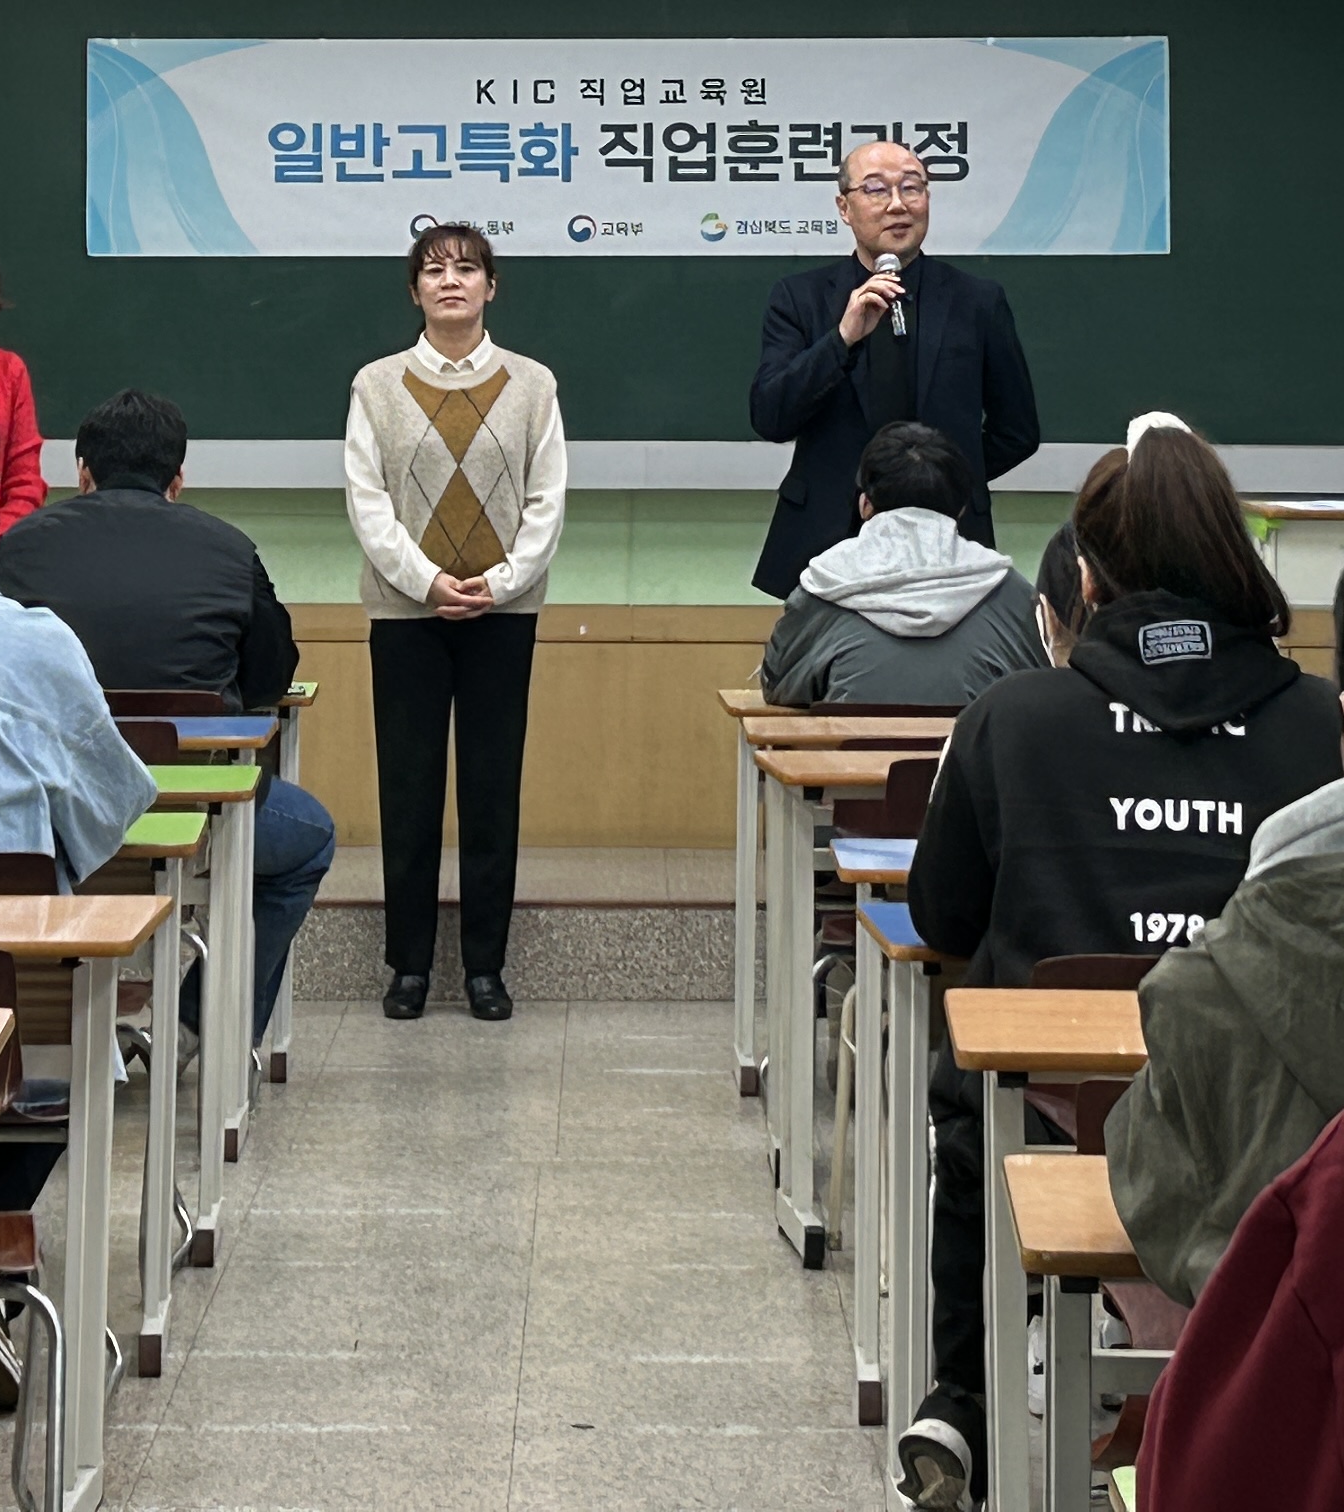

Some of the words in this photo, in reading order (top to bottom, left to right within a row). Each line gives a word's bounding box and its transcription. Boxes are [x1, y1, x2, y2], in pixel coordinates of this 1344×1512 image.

[475, 78, 556, 105] KIC
[579, 77, 768, 107] 직업교육원
[267, 121, 579, 184] 일반고특화
[600, 221, 644, 236] 교육부
[1109, 797, 1244, 835] YOUTH
[1129, 911, 1206, 944] 1978
